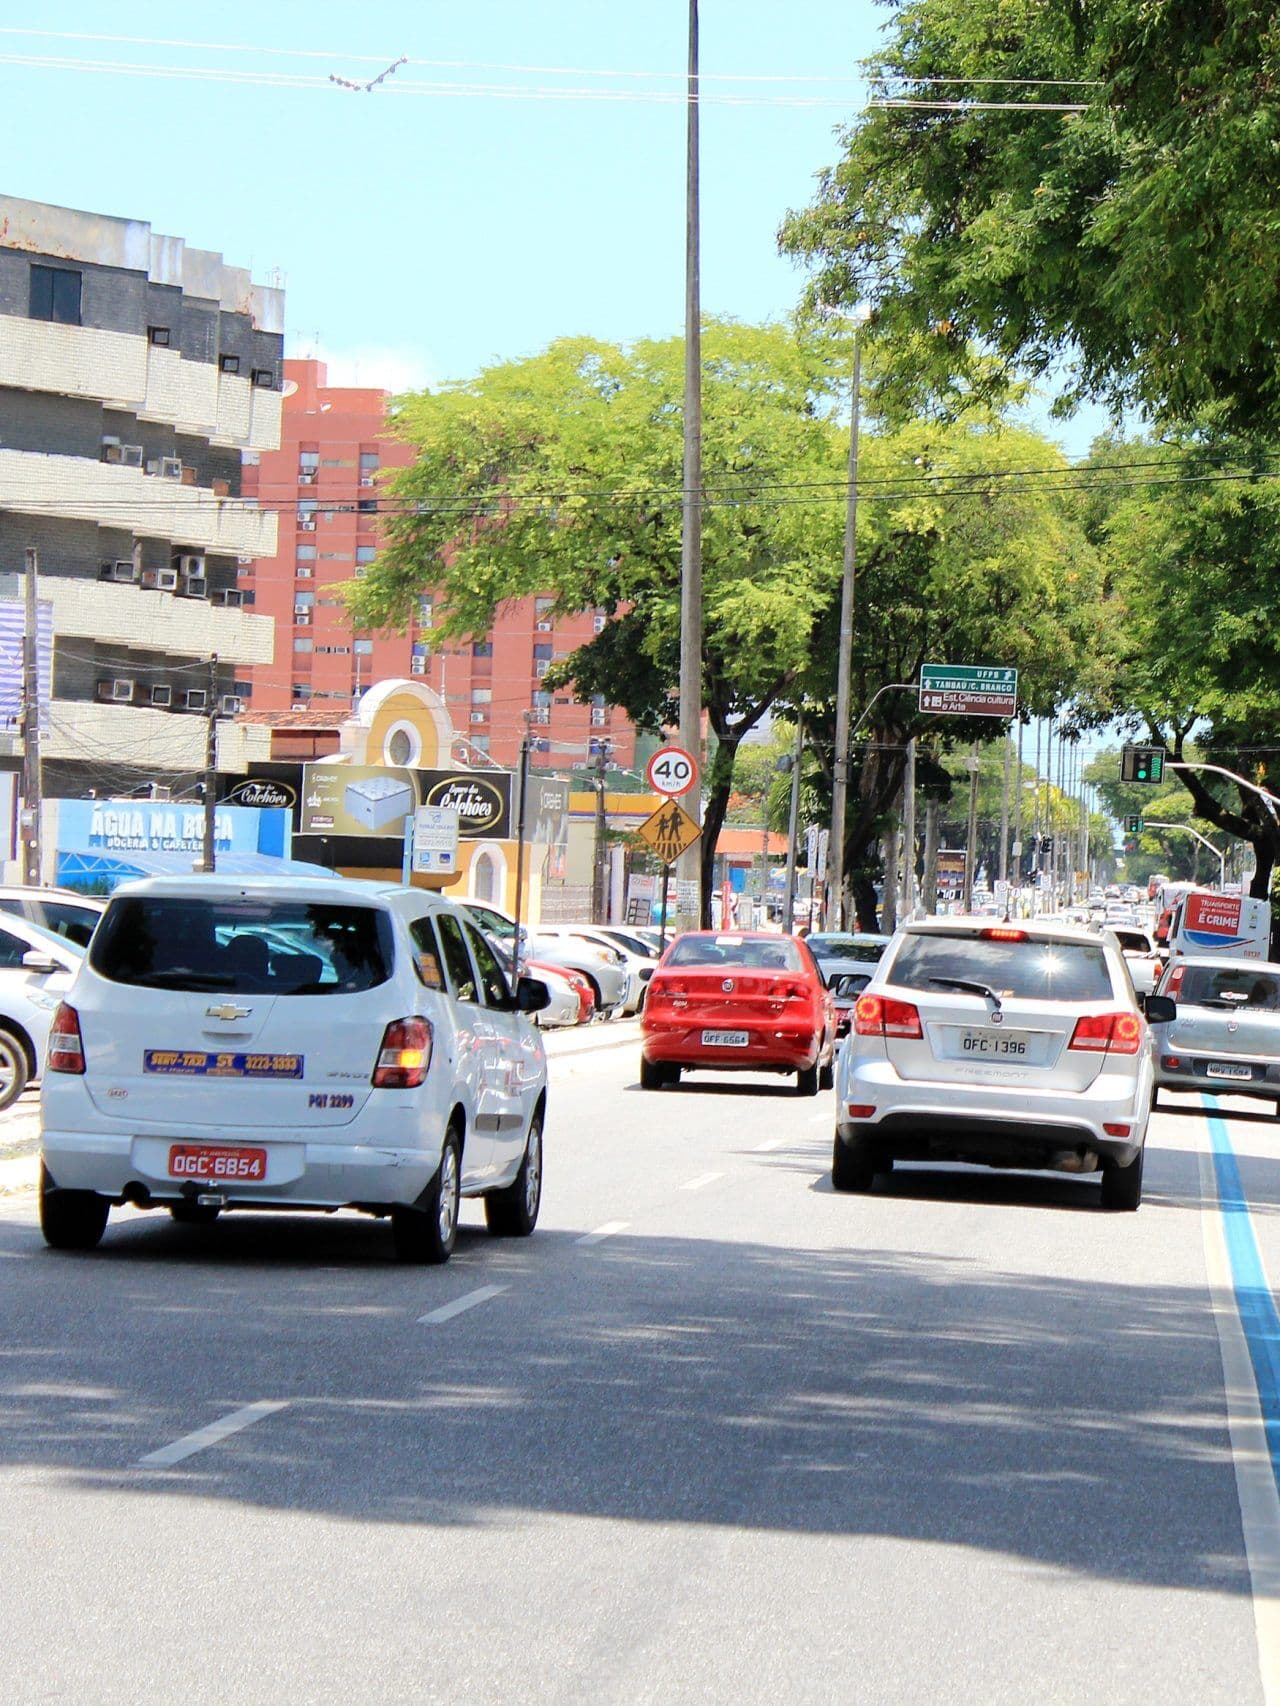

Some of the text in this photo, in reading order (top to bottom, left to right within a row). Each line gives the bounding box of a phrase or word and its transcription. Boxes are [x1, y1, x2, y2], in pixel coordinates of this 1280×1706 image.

[977, 670, 999, 679] UFPB
[981, 682, 1013, 692] BRANCO
[986, 696, 1014, 706] cultura
[949, 702, 966, 711] Arte
[654, 760, 690, 779] 40
[90, 801, 234, 840] ÁGUA NA BOA
[1198, 910, 1206, 924] É
[1206, 914, 1238, 928] CRIME
